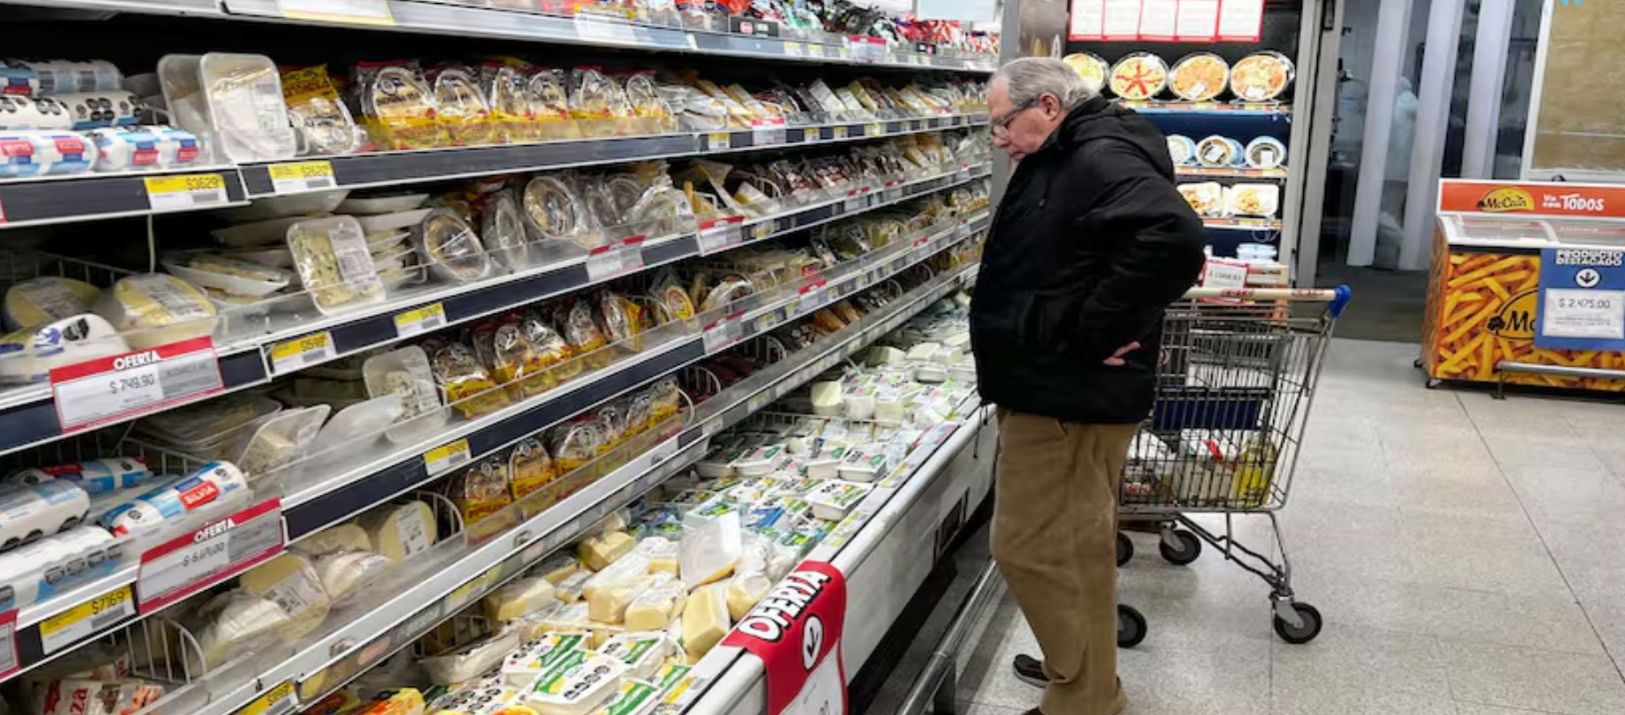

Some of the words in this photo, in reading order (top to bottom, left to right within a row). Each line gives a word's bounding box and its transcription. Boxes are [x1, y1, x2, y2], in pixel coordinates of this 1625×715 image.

[1487, 194, 1527, 209] McCain
[1560, 193, 1605, 212] TODOS
[1558, 298, 1566, 309] $
[113, 350, 160, 370] OFERTA
[109, 381, 119, 395] $
[194, 518, 235, 544] OFERTA
[737, 570, 831, 640] OFERTA
